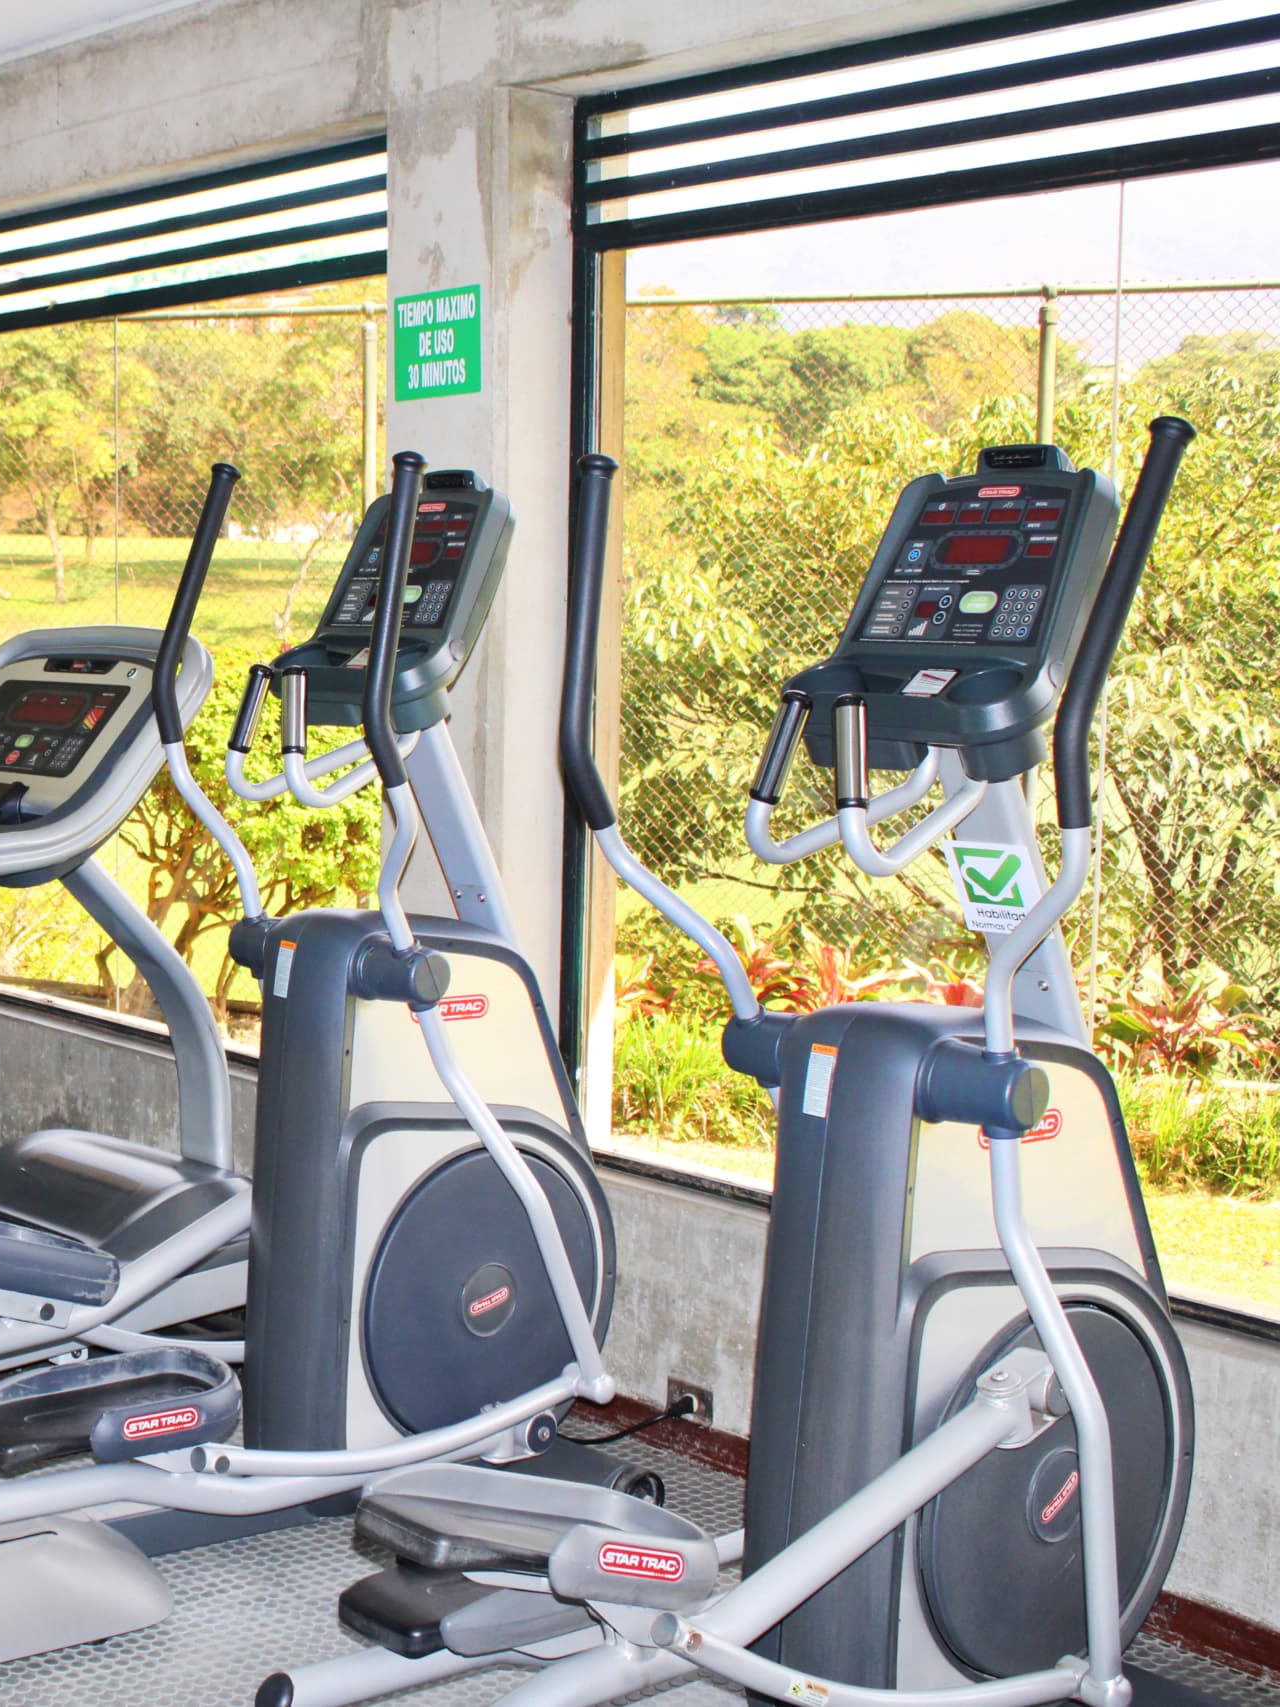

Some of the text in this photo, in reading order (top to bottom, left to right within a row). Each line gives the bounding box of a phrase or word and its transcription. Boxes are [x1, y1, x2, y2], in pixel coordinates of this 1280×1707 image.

[398, 293, 476, 328] TIEMPO MAXIMO
[419, 328, 454, 357] DE USO
[408, 358, 466, 389] 30 MINUTOS
[450, 1001, 483, 1014] TRAC
[127, 1412, 193, 1433] STAR TRAC
[603, 1551, 677, 1572] STAR TRAC
